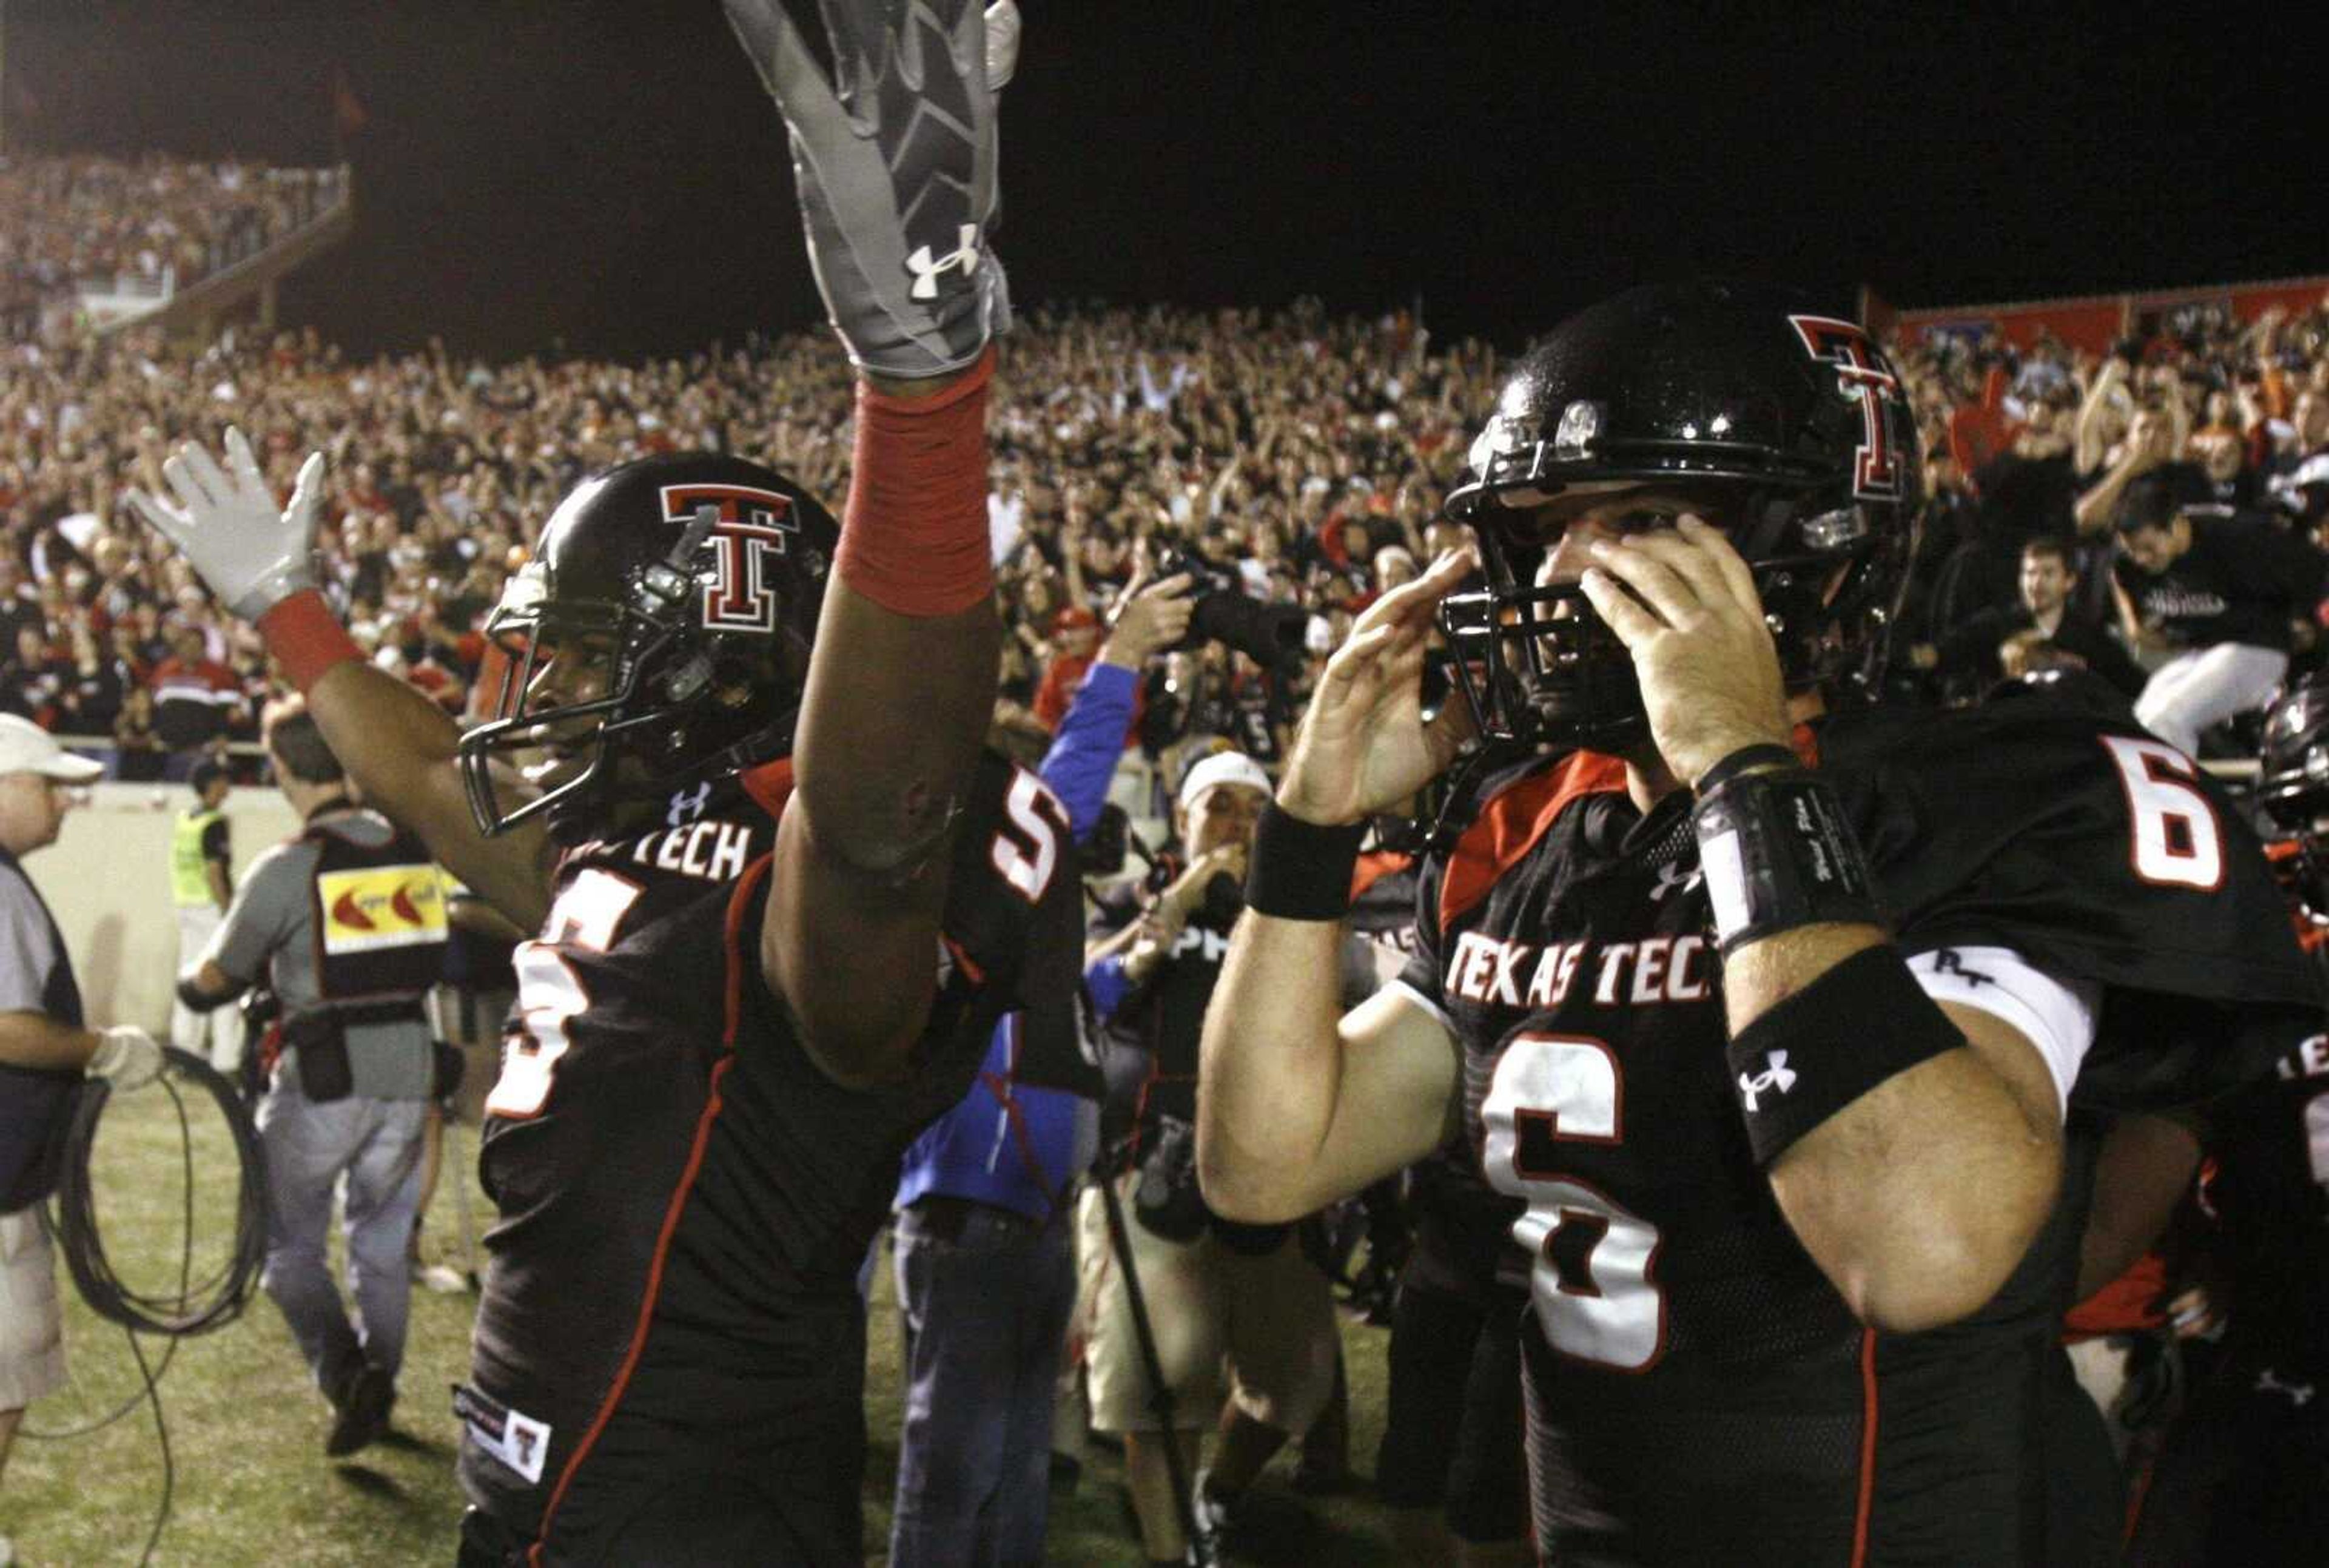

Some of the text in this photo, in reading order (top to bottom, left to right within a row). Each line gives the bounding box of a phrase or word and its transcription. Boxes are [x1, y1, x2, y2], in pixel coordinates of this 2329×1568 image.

[2097, 733, 2228, 893] 6
[1591, 933, 1713, 1006] TEC
[1480, 1030, 1668, 1376] 6
